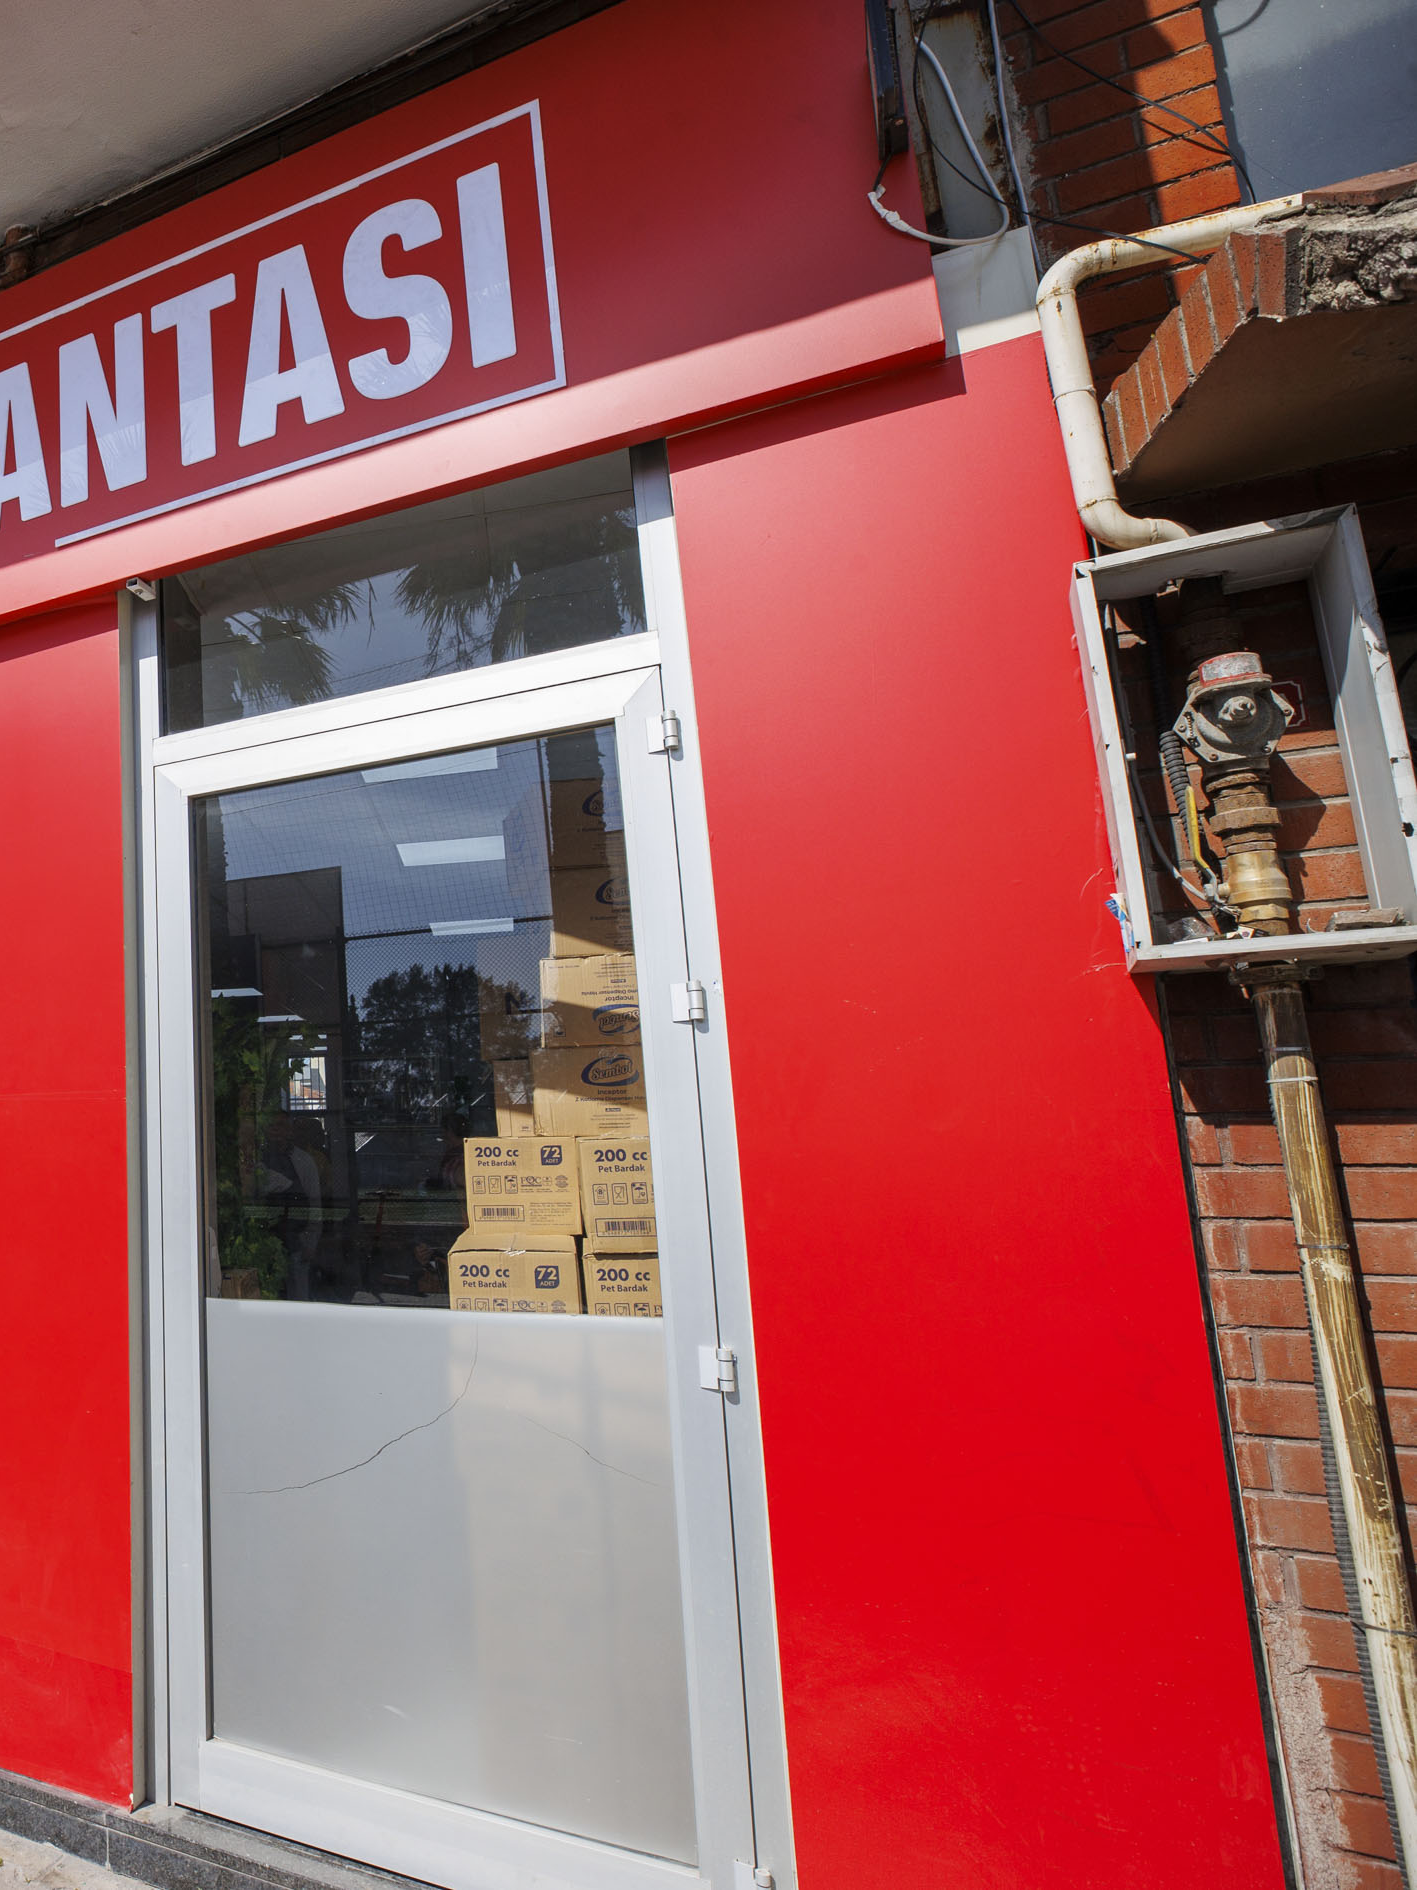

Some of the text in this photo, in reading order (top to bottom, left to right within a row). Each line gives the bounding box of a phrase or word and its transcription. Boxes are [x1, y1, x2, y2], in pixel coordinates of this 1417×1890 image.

[474, 1146, 519, 1158] 200 cc
[542, 1147, 561, 1159] 72
[594, 1148, 648, 1162] 200 cc
[598, 1164, 646, 1173] Pet Bardak
[459, 1264, 510, 1278] 200 cc
[536, 1267, 558, 1280] 72
[596, 1268, 651, 1282] 200 cc
[462, 1280, 507, 1288] Pet Bardak
[600, 1283, 648, 1292] Pet Bardak
